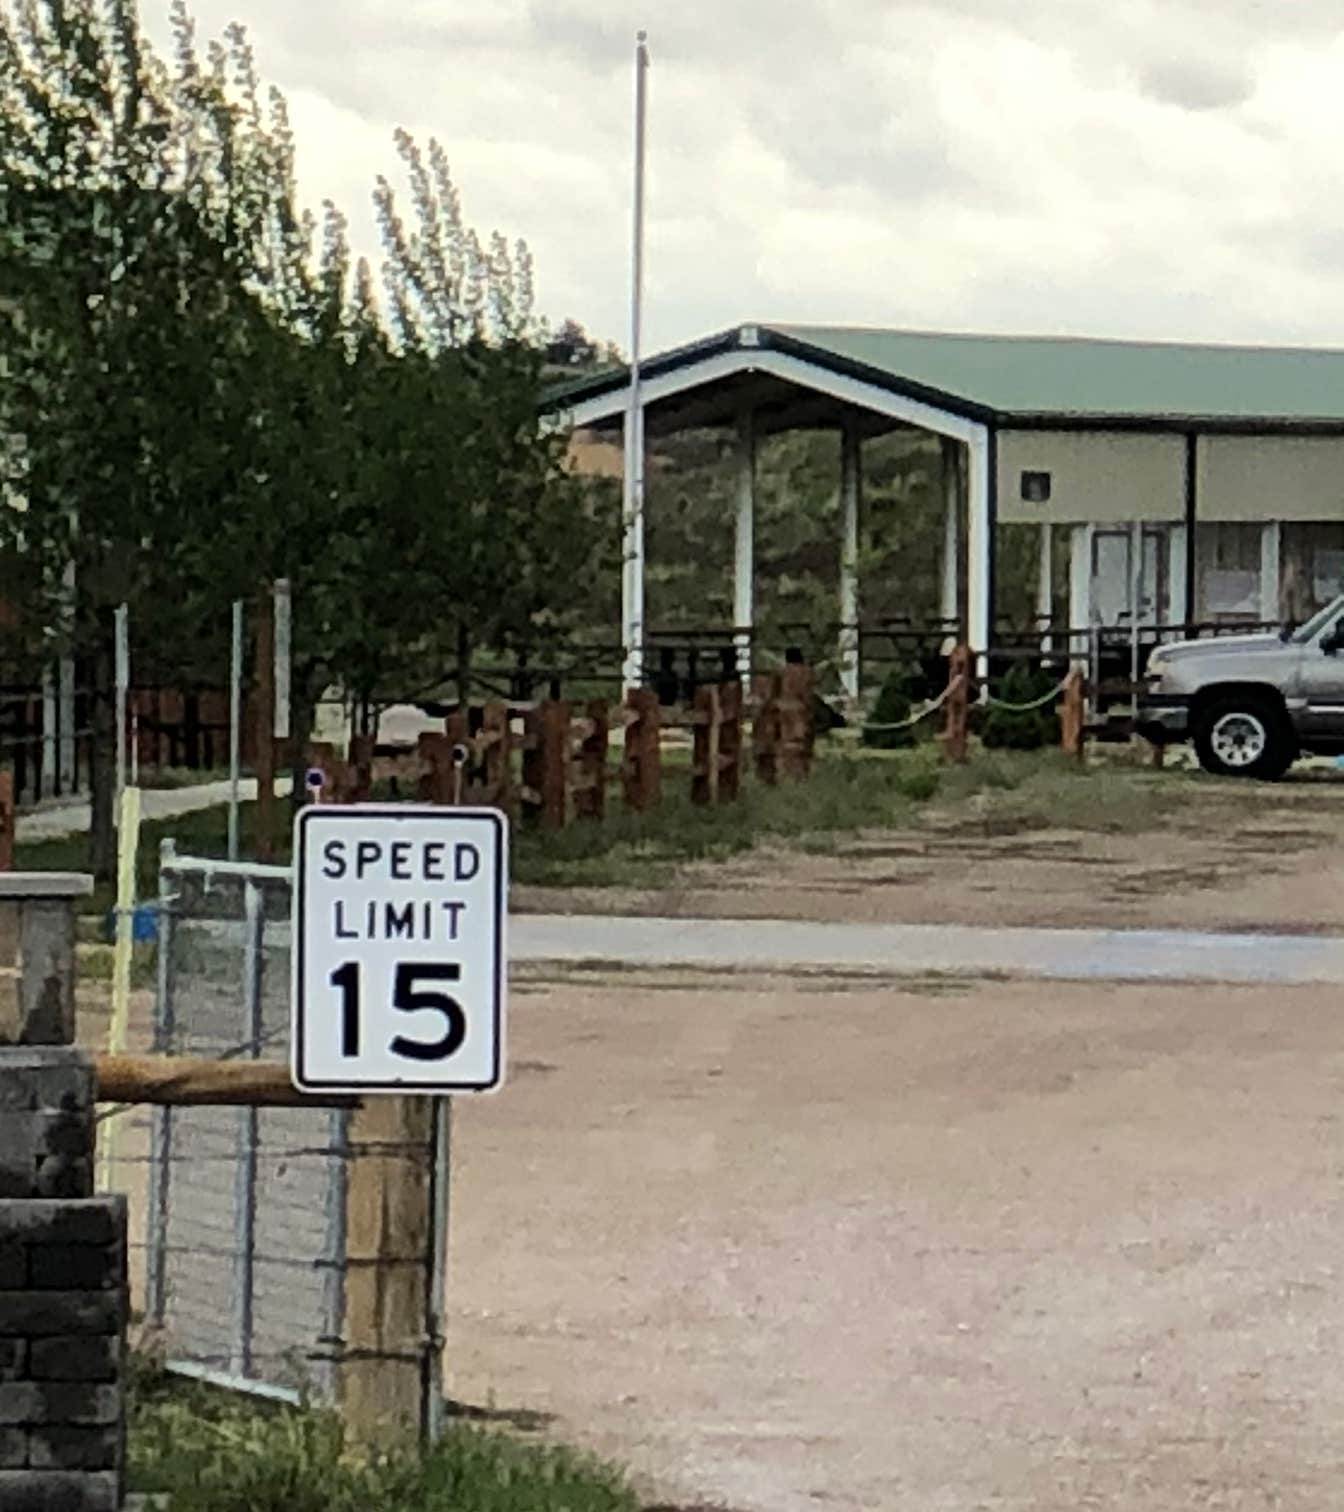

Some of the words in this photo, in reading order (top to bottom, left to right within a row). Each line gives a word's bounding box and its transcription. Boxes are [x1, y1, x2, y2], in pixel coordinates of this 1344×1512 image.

[322, 840, 480, 881] SPEED
[334, 900, 466, 940] LIMIT
[330, 961, 466, 1062] 15
